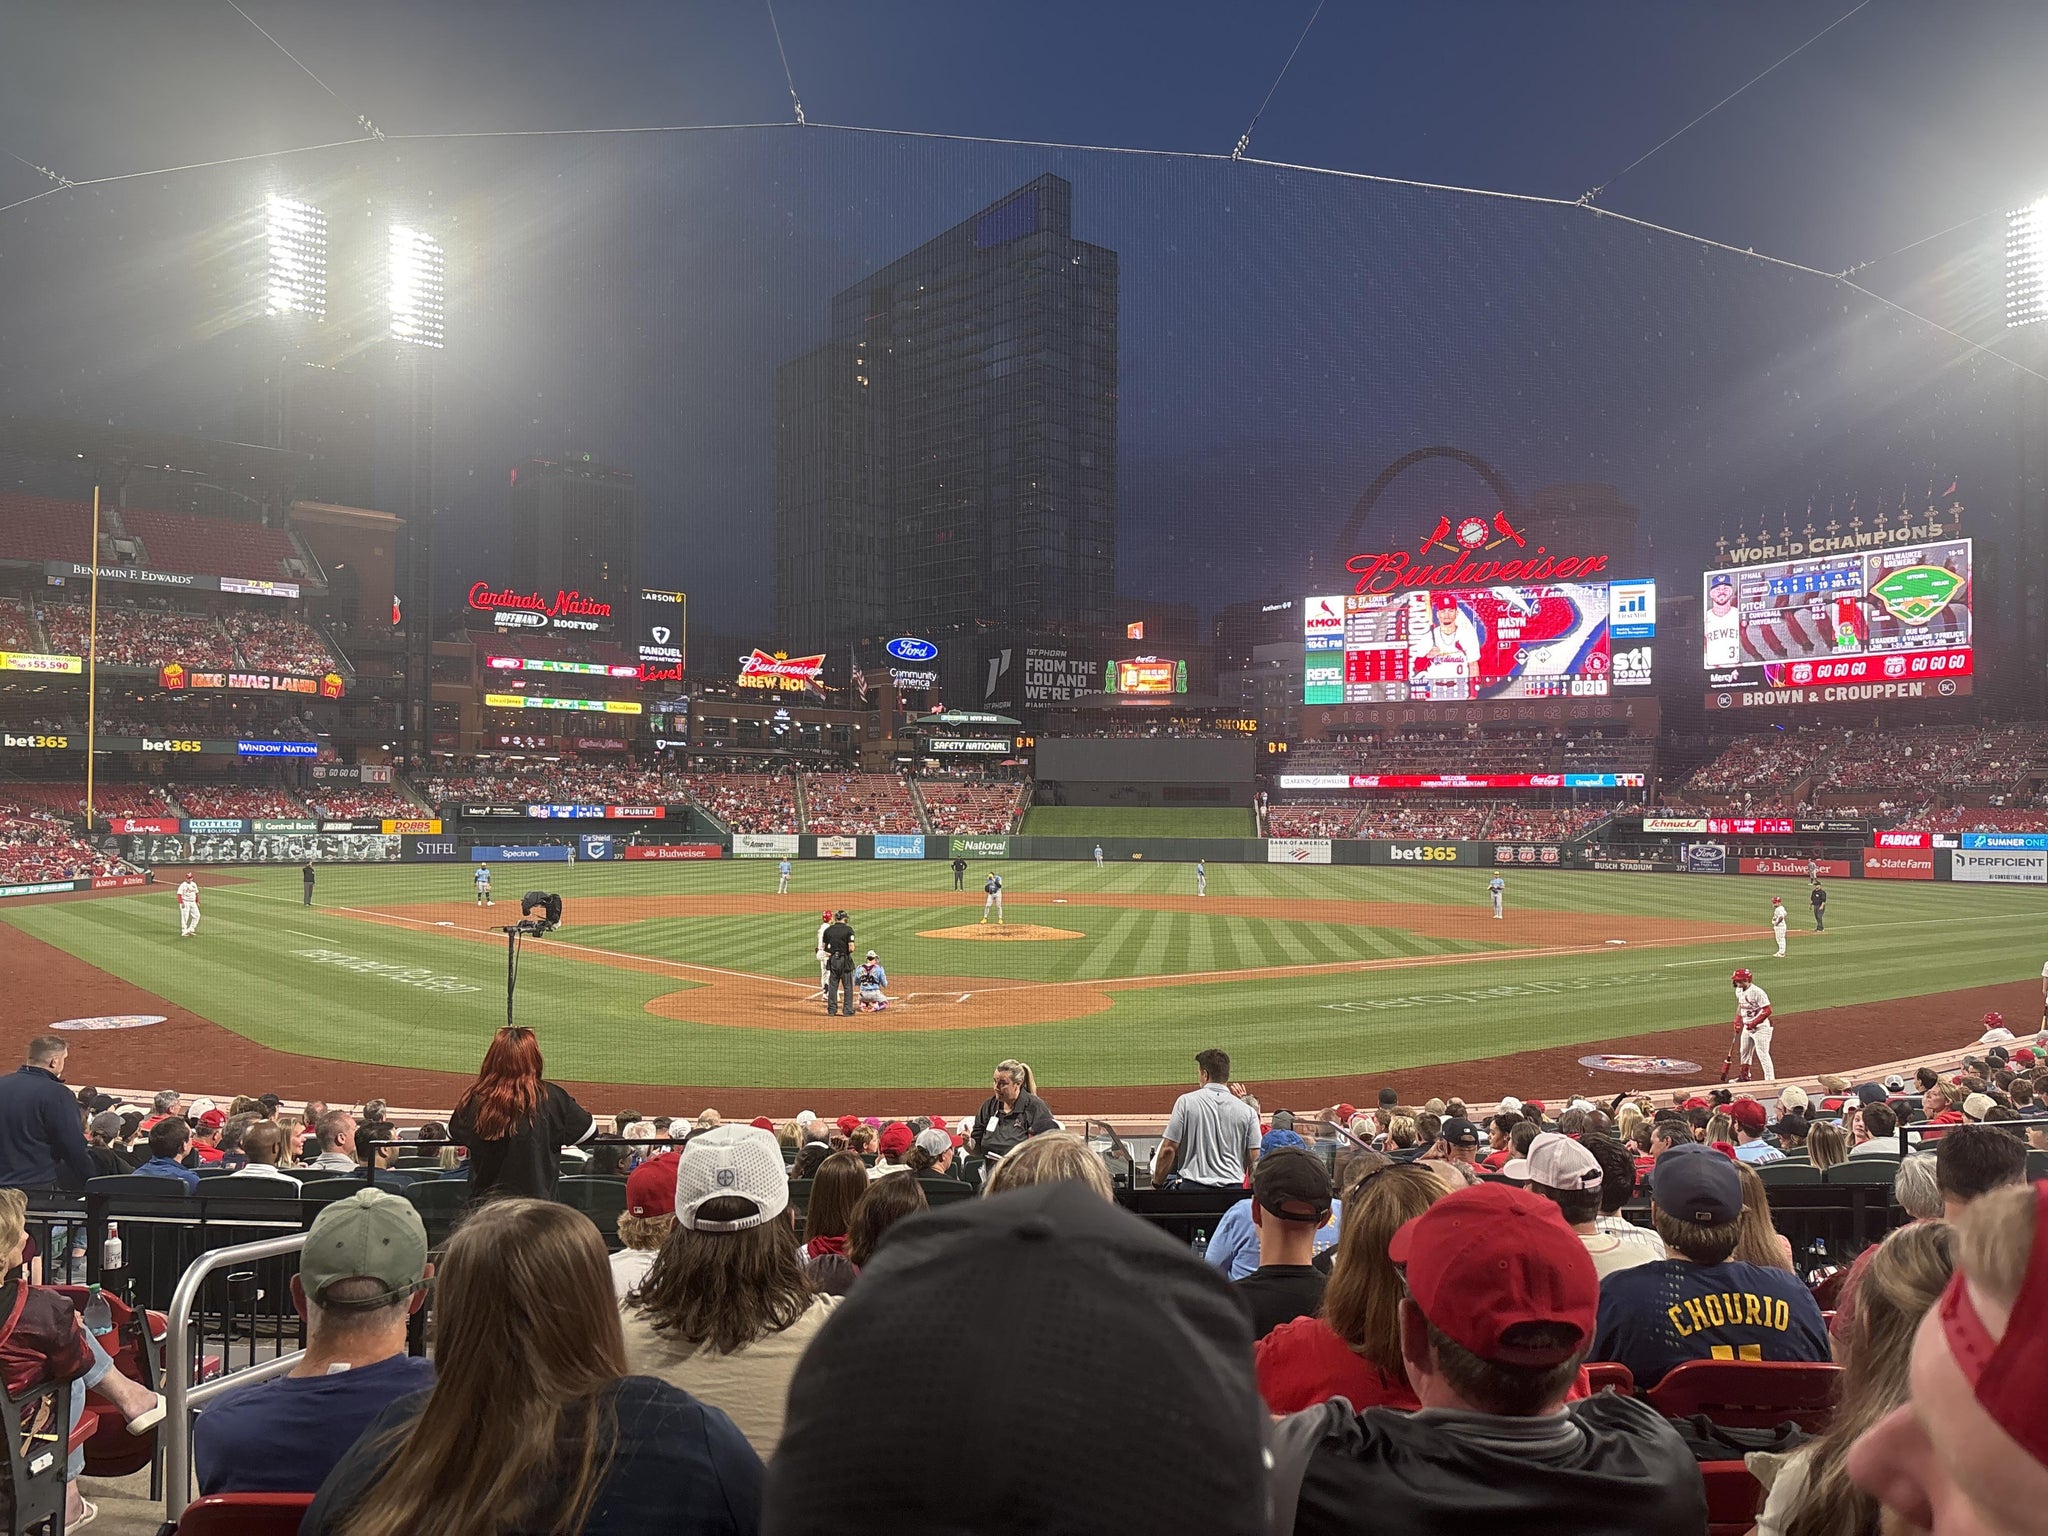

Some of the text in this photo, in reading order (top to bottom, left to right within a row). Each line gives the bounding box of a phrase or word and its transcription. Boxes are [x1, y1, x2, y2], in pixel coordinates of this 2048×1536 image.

[1729, 523, 1944, 564] WORLD CHAMPIONS
[1883, 551, 1922, 561] MILWAUKEE
[1883, 559, 1917, 569] BREWERS
[130, 569, 138, 580] F.
[1345, 546, 1608, 595] Budweiser
[1773, 586, 1788, 594] 15.1
[1792, 584, 1798, 592] 9
[1805, 583, 1813, 591] 11
[468, 580, 612, 617] Cardinals Nation
[641, 592, 675, 603] LARSON
[1262, 603, 1282, 612] Anthem
[1741, 601, 1766, 612] PITCH
[494, 611, 599, 631] HOFFMANN ROOFTOP
[1307, 618, 1341, 628] KMOX
[1498, 618, 1526, 628] MASYN
[1498, 629, 1520, 639] WINN
[897, 641, 928, 657] Ford
[1307, 640, 1328, 649] 104.1
[1329, 640, 1343, 648] FM
[639, 646, 683, 658] FANDUEL
[738, 656, 824, 676] Budweiser
[1025, 658, 1098, 675] FROM THE
[1888, 663, 1901, 672] 66
[1912, 655, 1965, 671] GO GO GO
[639, 663, 683, 682] Live!
[889, 668, 937, 681] Community
[1307, 668, 1343, 681] REPEL
[1457, 664, 1463, 675] 0
[1613, 670, 1652, 679] TODAY
[1794, 671, 1808, 679] 66
[1817, 662, 1866, 677] GO GO GO
[228, 673, 271, 689] MAC
[272, 675, 318, 694] LAND
[738, 674, 777, 690] BREW
[1025, 673, 1087, 688] LOU AND
[1711, 673, 1733, 683] Mercy
[1025, 686, 1070, 700] WE'RE
[1742, 683, 1922, 706] BROWN & CROUPPEN
[1355, 711, 1364, 723] 2
[1370, 711, 1380, 722] 6
[1386, 711, 1395, 722] 9
[1403, 710, 1416, 722] 10
[1424, 709, 1438, 721] 14
[1445, 708, 1459, 721] 17
[1466, 708, 1483, 720] 20
[1493, 708, 1510, 720] 23
[1518, 707, 1536, 719] 24
[1544, 706, 1562, 719] 42
[1570, 706, 1589, 719] 45
[1215, 719, 1257, 731] SMOKE
[4, 734, 68, 748] bet365
[142, 738, 202, 753] bet365
[933, 742, 1007, 751] SAFETY NATIONAL
[238, 743, 318, 754] WINDOW NATION
[329, 768, 339, 777] GO
[339, 769, 349, 777] GO
[349, 770, 359, 778] GO
[469, 807, 486, 815] Mercy
[191, 820, 241, 828] ROTTLER
[265, 822, 317, 831] Central Bank
[395, 822, 431, 830] DOBBS
[1648, 819, 1700, 828] Schnucks
[1802, 823, 1820, 831] Mercy
[582, 834, 610, 842] CarShield
[1880, 834, 1922, 846] FABICK
[416, 841, 456, 854] STIFEL
[750, 840, 774, 848] Ameren
[964, 840, 1005, 850] National
[502, 850, 537, 859] Spectrum
[659, 849, 705, 858] Budweiser
[1390, 845, 1457, 861] bet365
[1695, 848, 1717, 857] Ford
[1594, 862, 1653, 871] BUSCH STADIUM
[1968, 857, 2045, 867] PERFICIENT
[1667, 1293, 1790, 1337] CHOURIO
